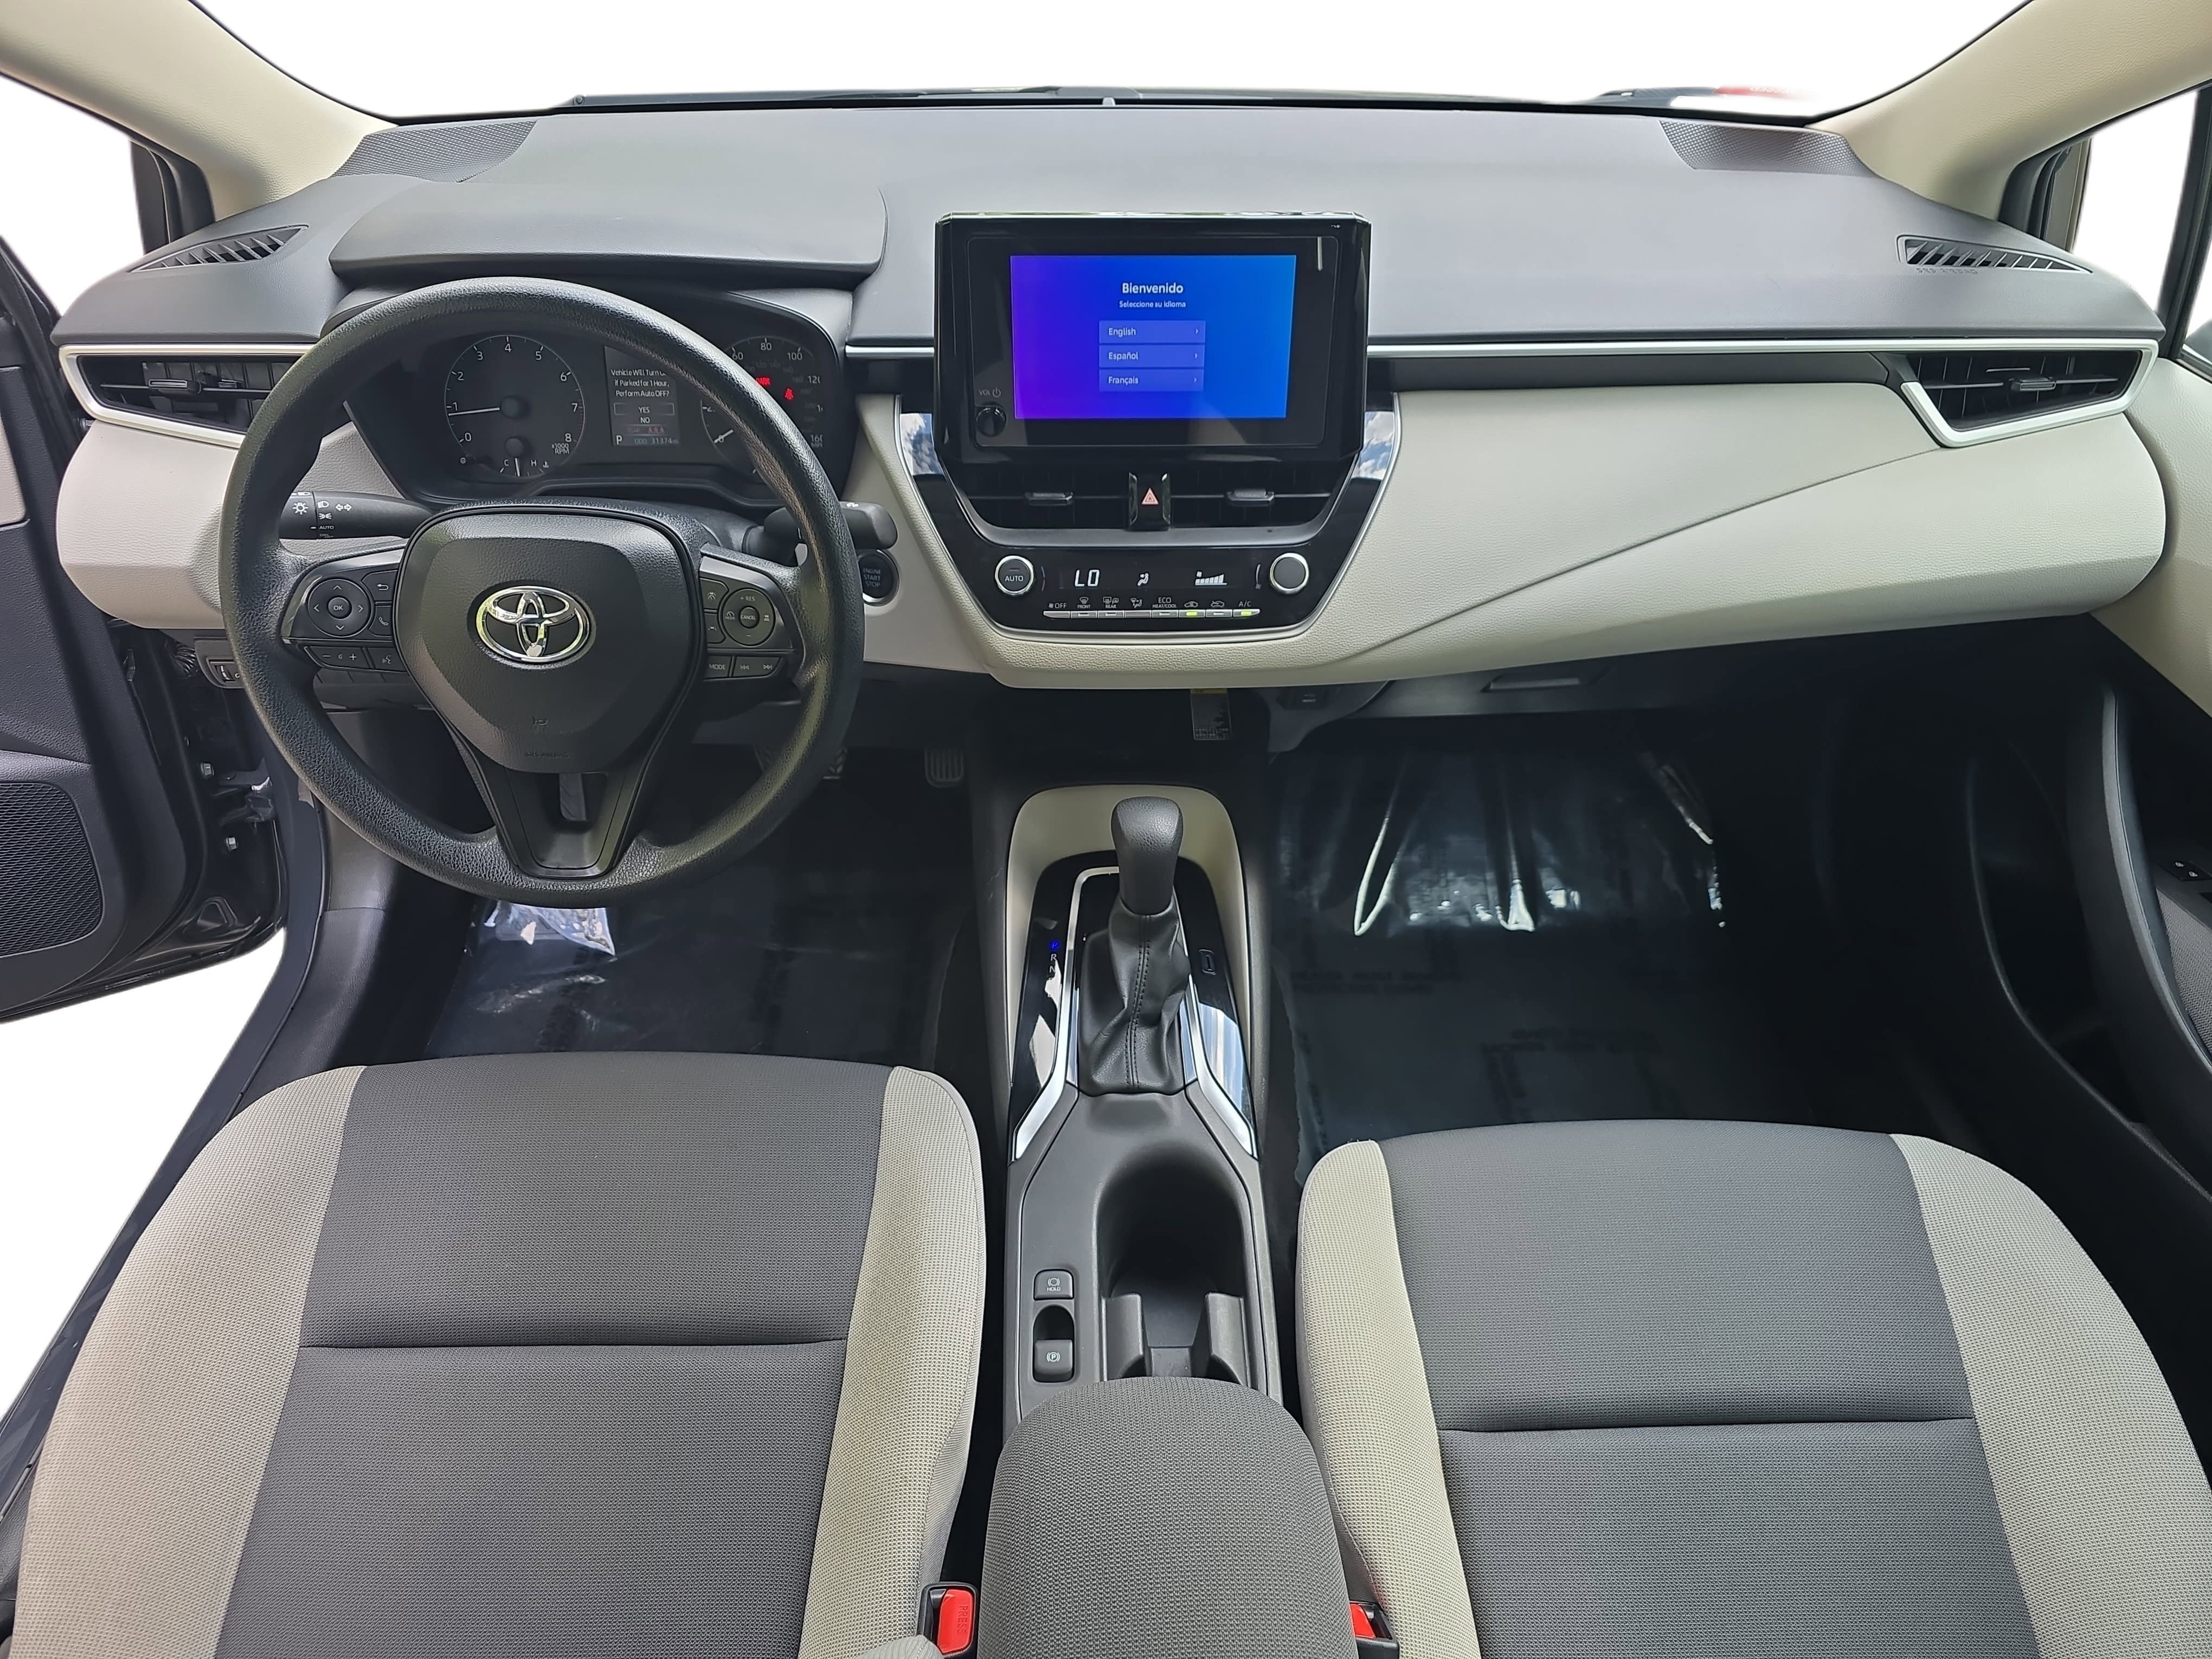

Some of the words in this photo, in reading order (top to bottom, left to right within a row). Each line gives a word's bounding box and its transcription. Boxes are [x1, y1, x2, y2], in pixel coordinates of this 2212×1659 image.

[1122, 282, 1184, 294] Bienvenido
[1108, 327, 1136, 338] English
[505, 343, 512, 352] 4
[761, 343, 772, 351] 80
[477, 351, 484, 361] 3
[535, 351, 542, 361] 5
[732, 352, 743, 360] 60
[787, 352, 802, 361] 100
[1108, 351, 1139, 361] Español
[457, 371, 465, 381] 2
[560, 372, 567, 382] 6
[1108, 376, 1139, 385] Français
[453, 402, 458, 411] 1
[571, 403, 578, 412] 7
[465, 433, 472, 442] 0
[565, 433, 572, 442] 8
[616, 435, 622, 445] P
[1074, 569, 1101, 587] LO
[957, 1604, 968, 1635] PRESS
